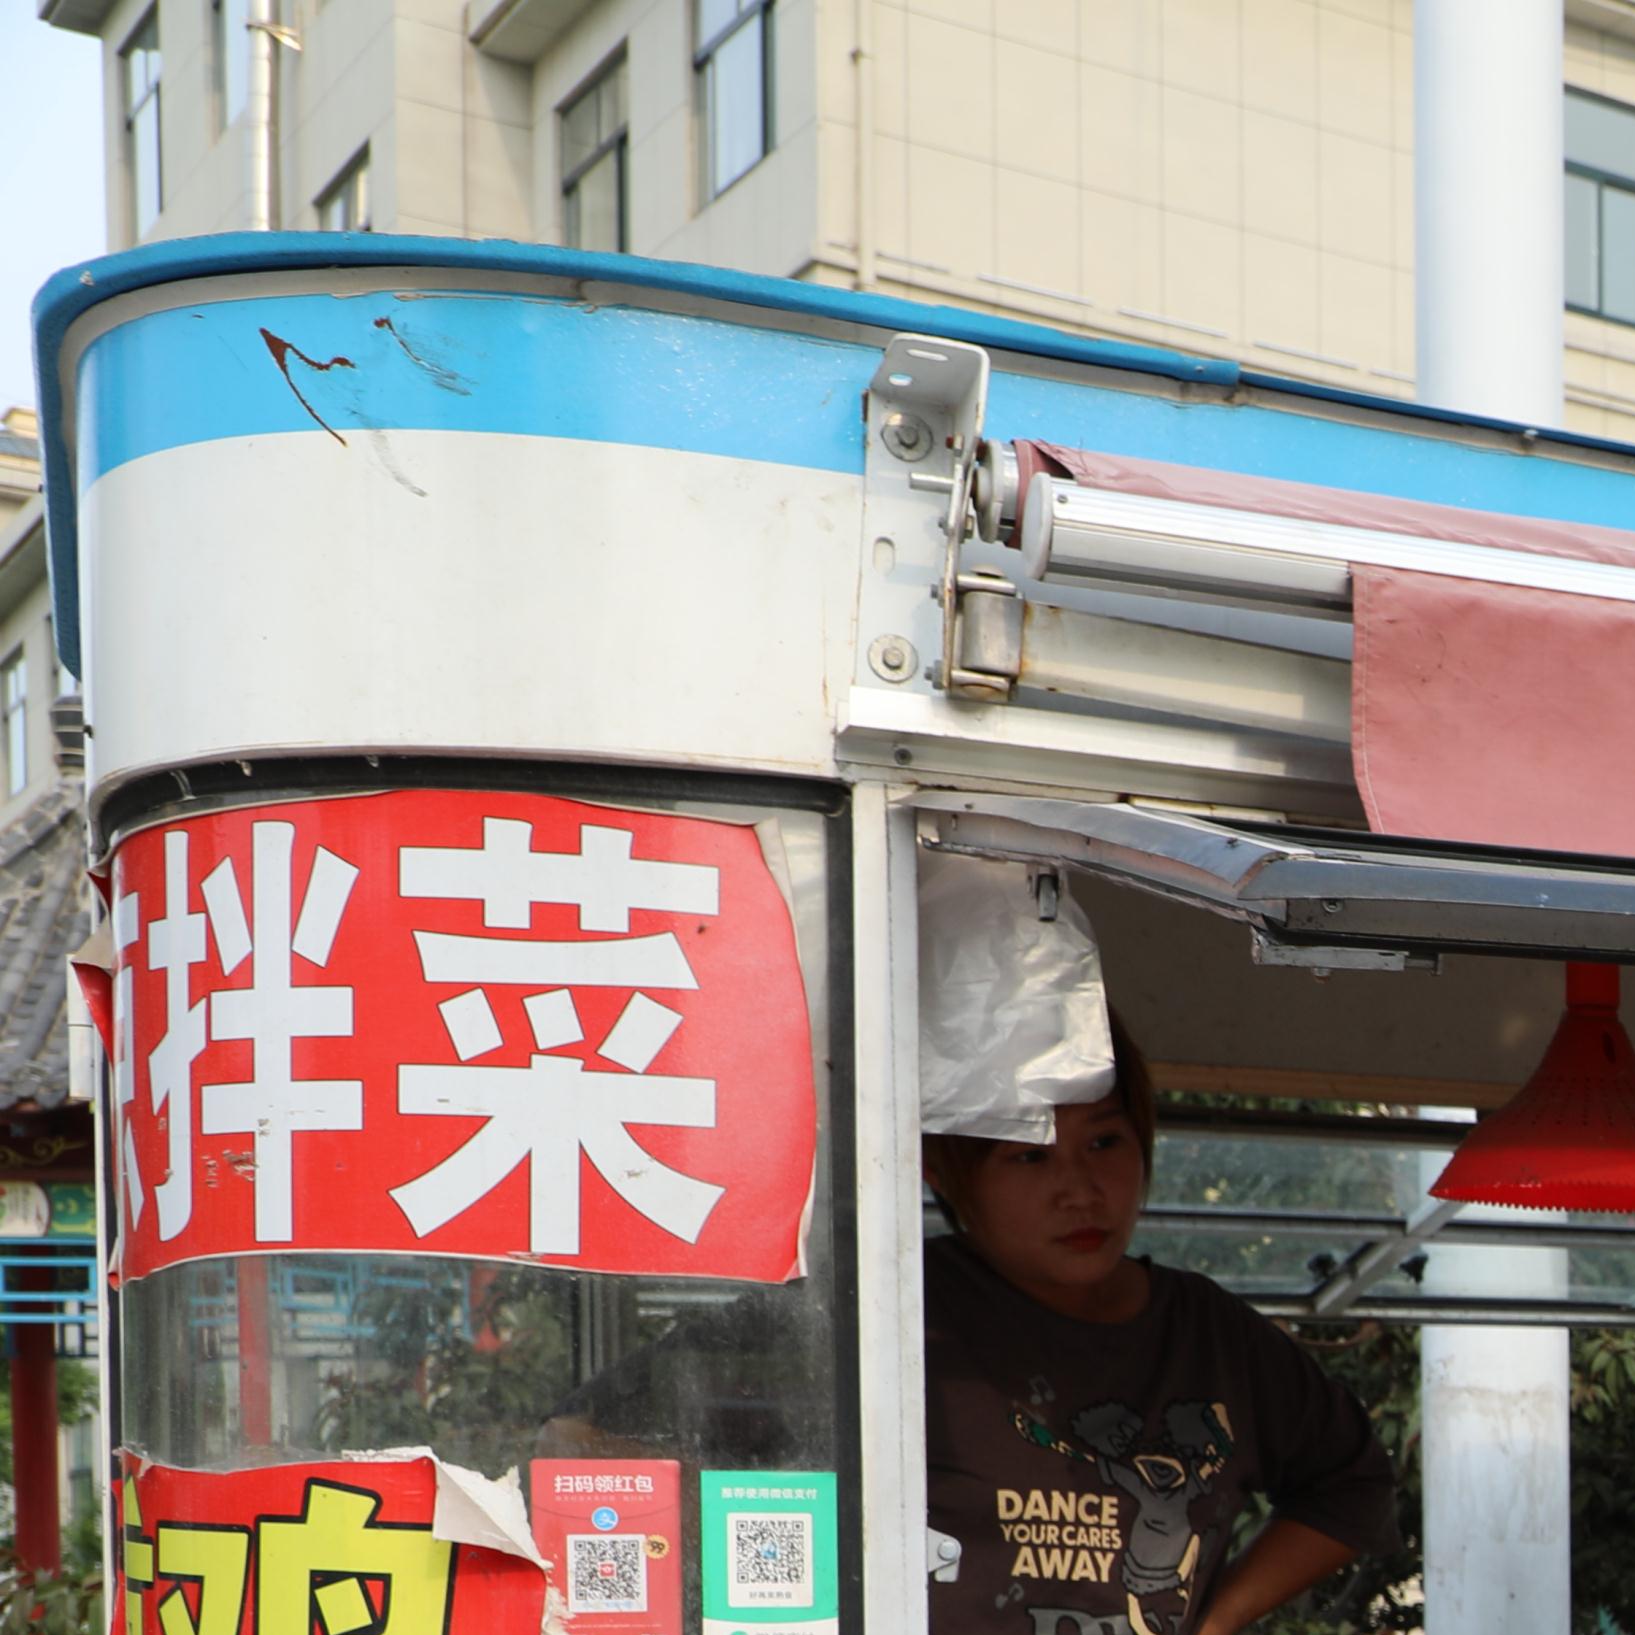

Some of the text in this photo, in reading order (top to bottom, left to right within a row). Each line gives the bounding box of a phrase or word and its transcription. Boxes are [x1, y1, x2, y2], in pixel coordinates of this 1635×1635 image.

[112, 815, 727, 1255] 拌菜
[554, 1474, 654, 1494] 扫码领红包
[720, 1487, 818, 1500] 推荐使用微信支付
[997, 1489, 1119, 1526] DANCE
[1001, 1523, 1122, 1549] YOUR CARES
[1011, 1547, 1114, 1583] AWAY
